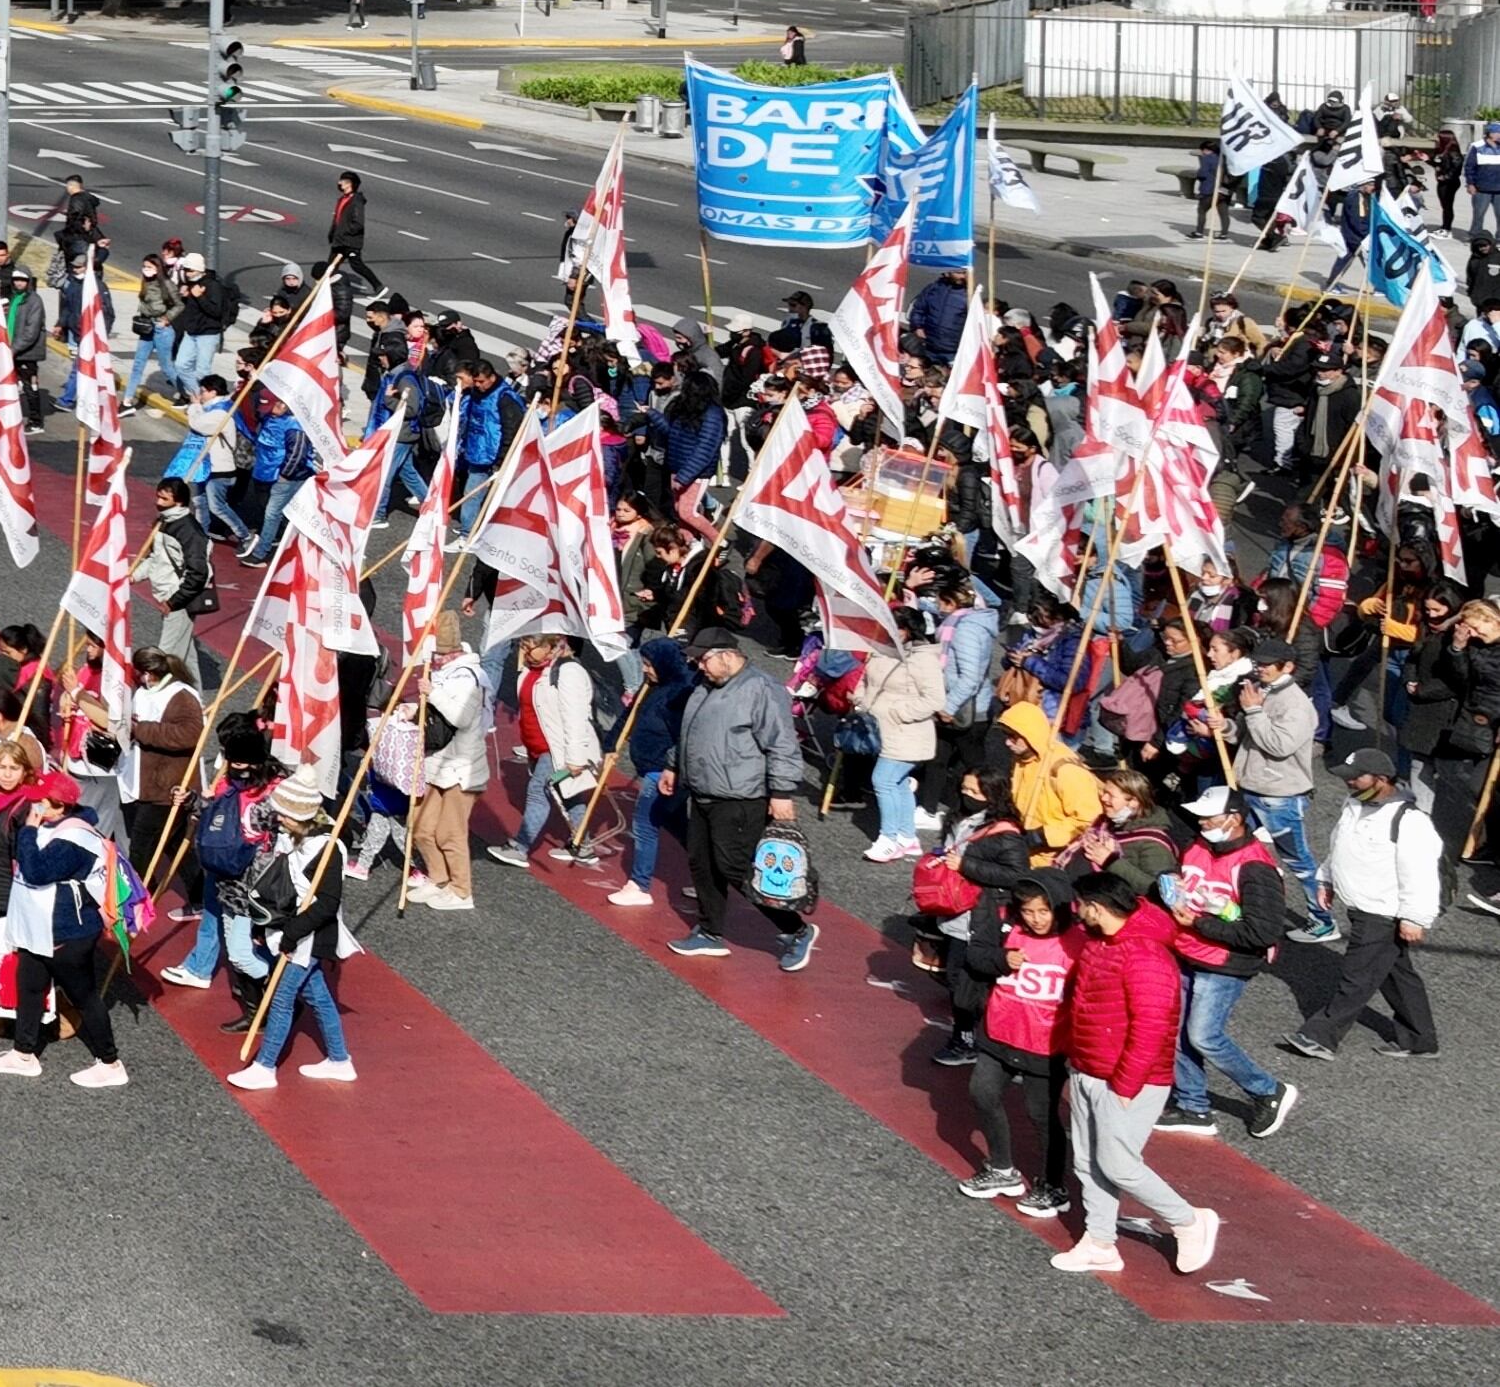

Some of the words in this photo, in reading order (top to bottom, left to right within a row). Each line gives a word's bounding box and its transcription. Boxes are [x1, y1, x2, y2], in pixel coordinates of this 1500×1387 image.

[707, 127, 840, 176] DE
[701, 206, 795, 230] OMAS
[480, 538, 517, 566] miento
[1019, 967, 1067, 995] ST
